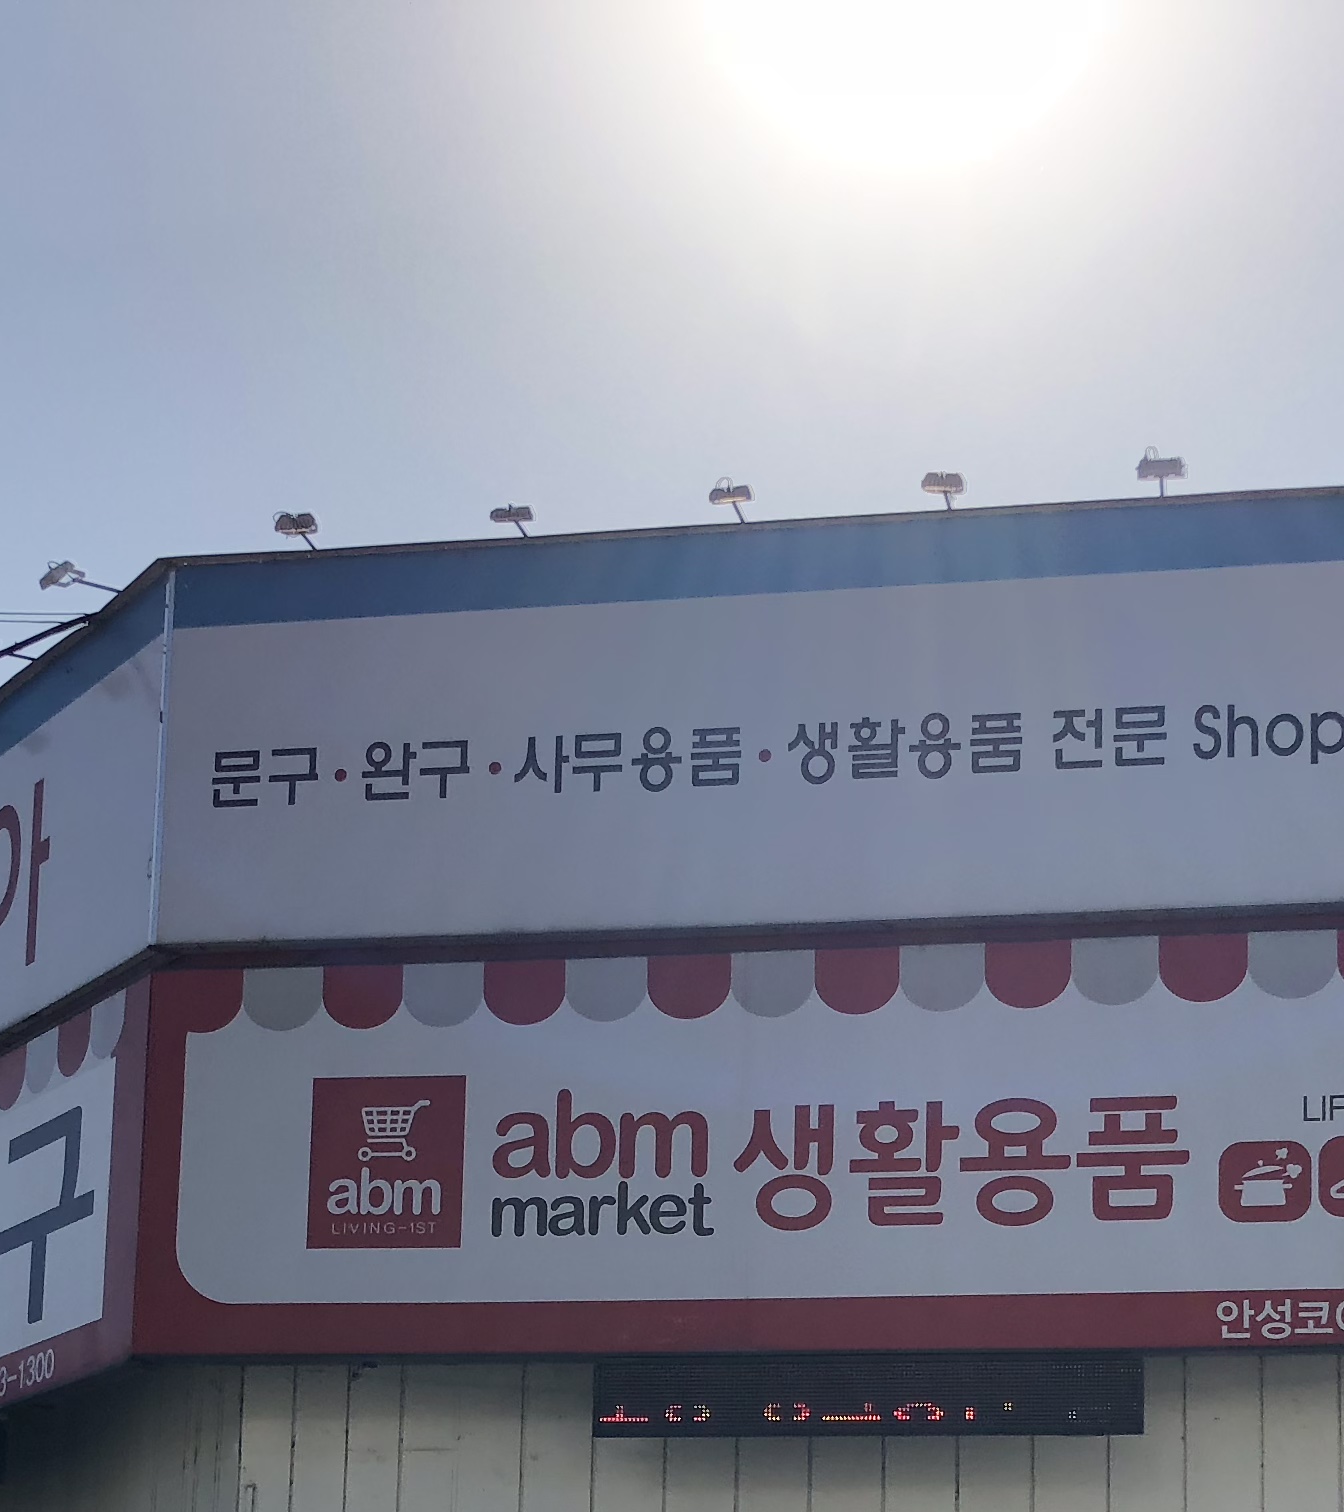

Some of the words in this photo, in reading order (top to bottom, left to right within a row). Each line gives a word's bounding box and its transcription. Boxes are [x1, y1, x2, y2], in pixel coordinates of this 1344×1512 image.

[1052, 704, 1167, 771] 전문
[491, 1088, 709, 1181] abm
[733, 1095, 1191, 1231] 생활용품
[327, 1166, 442, 1215] abm
[491, 1180, 715, 1237] market
